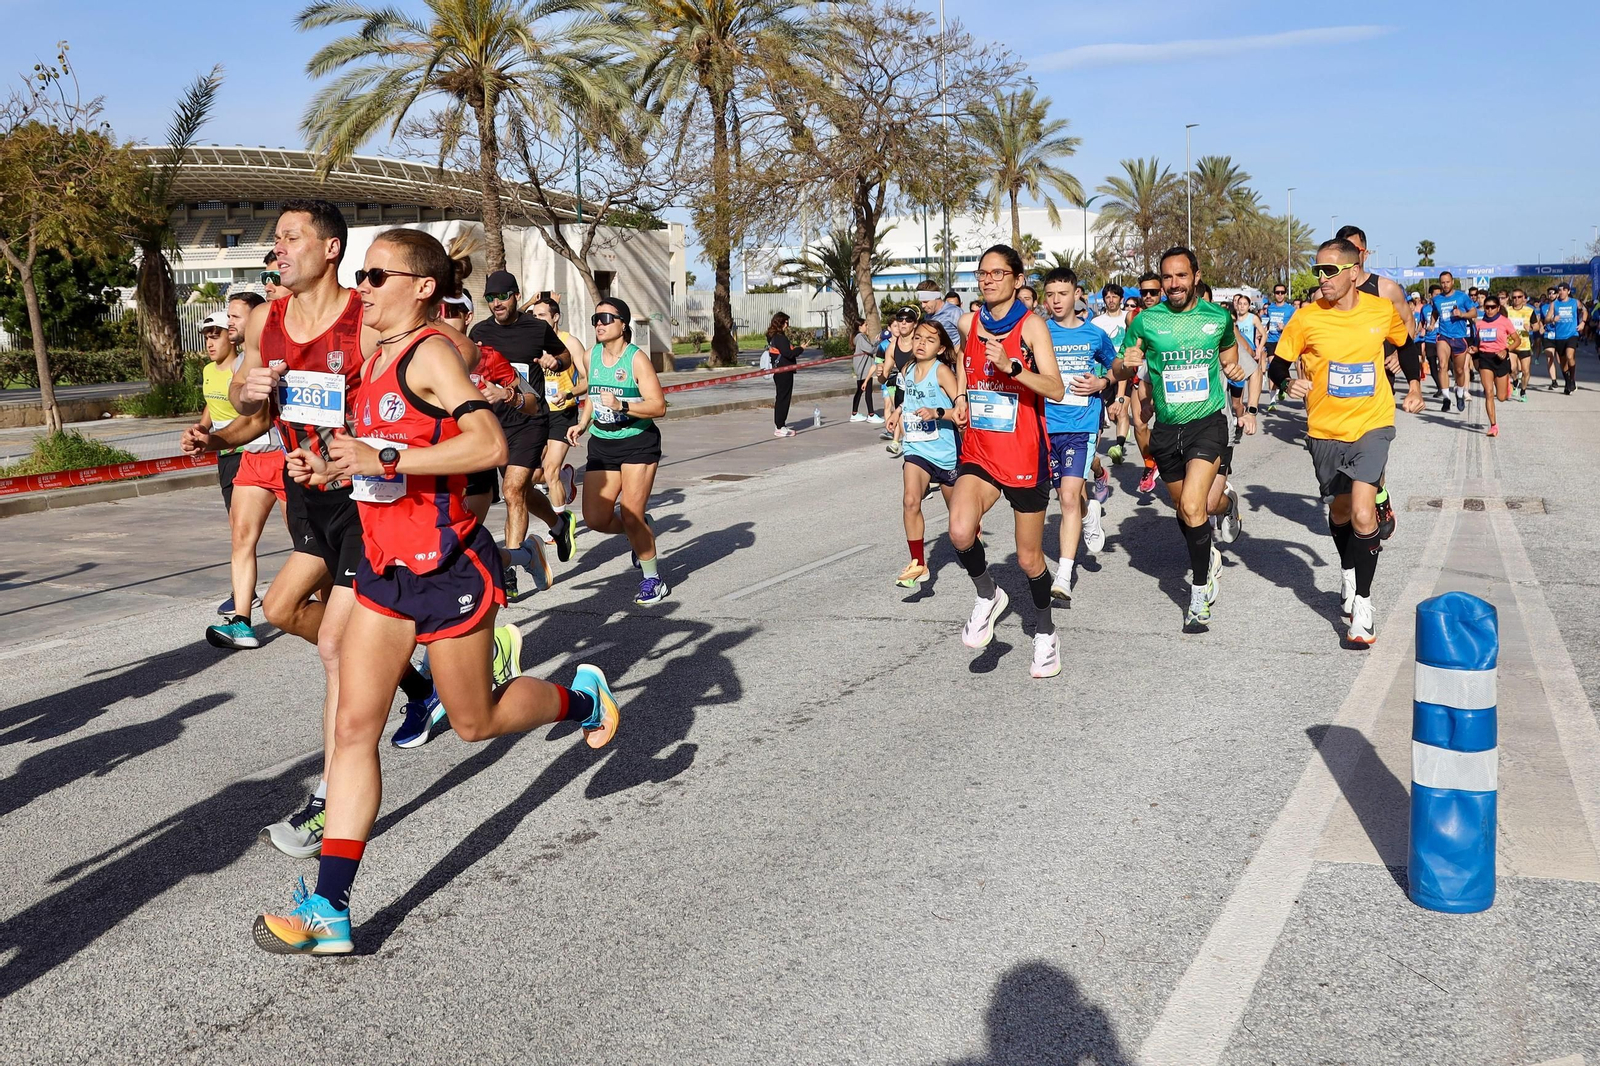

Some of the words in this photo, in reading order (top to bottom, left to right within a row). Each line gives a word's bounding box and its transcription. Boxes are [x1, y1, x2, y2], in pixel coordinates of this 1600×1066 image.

[1466, 267, 1495, 275] mayoral
[1053, 343, 1090, 353] mayoral
[1160, 346, 1214, 364] mijas
[1164, 363, 1210, 371] ATLETISMO
[1340, 374, 1363, 385] 125
[1172, 379, 1201, 391] 1917
[590, 386, 624, 397] ATLETISMO
[291, 387, 329, 407] 2661
[984, 404, 995, 414] 2
[907, 421, 929, 431] 2093
